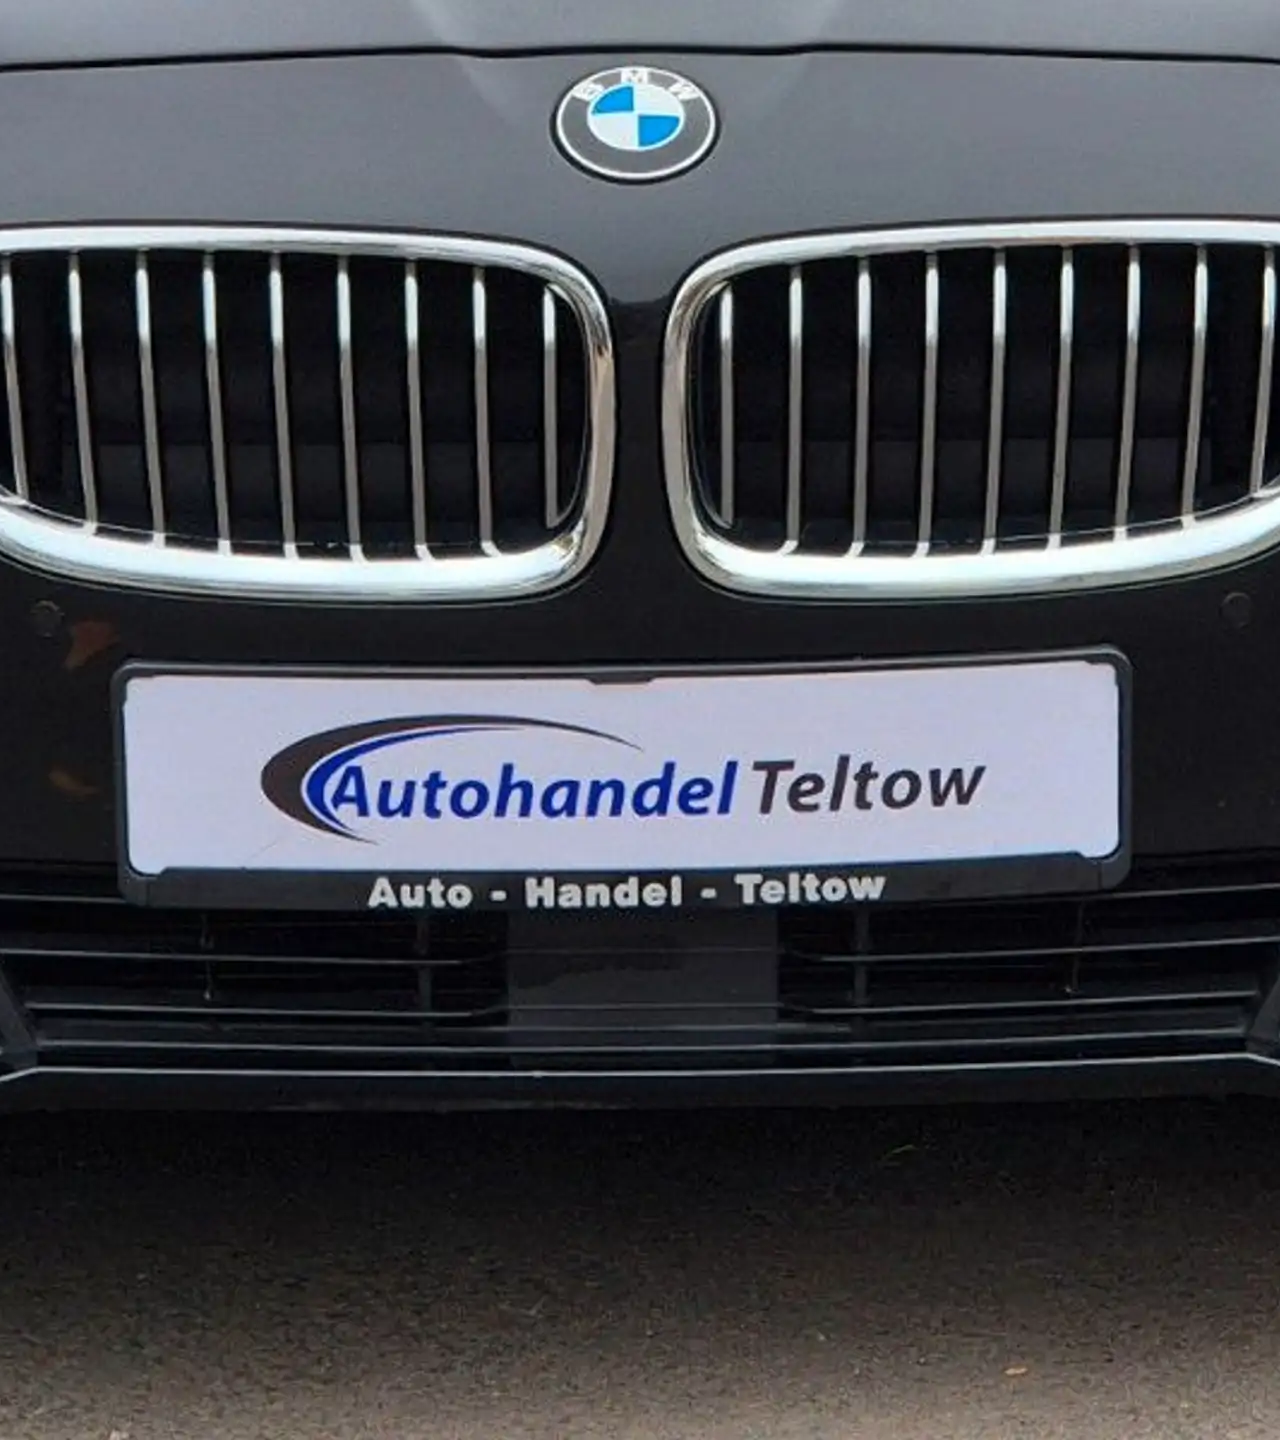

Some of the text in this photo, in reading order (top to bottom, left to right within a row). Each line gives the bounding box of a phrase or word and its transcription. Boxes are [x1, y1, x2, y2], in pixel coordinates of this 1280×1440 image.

[331, 754, 987, 818] Autohandel Teltow
[368, 876, 473, 909] Auto
[524, 875, 683, 908] Handel
[733, 872, 887, 905] Teltow
